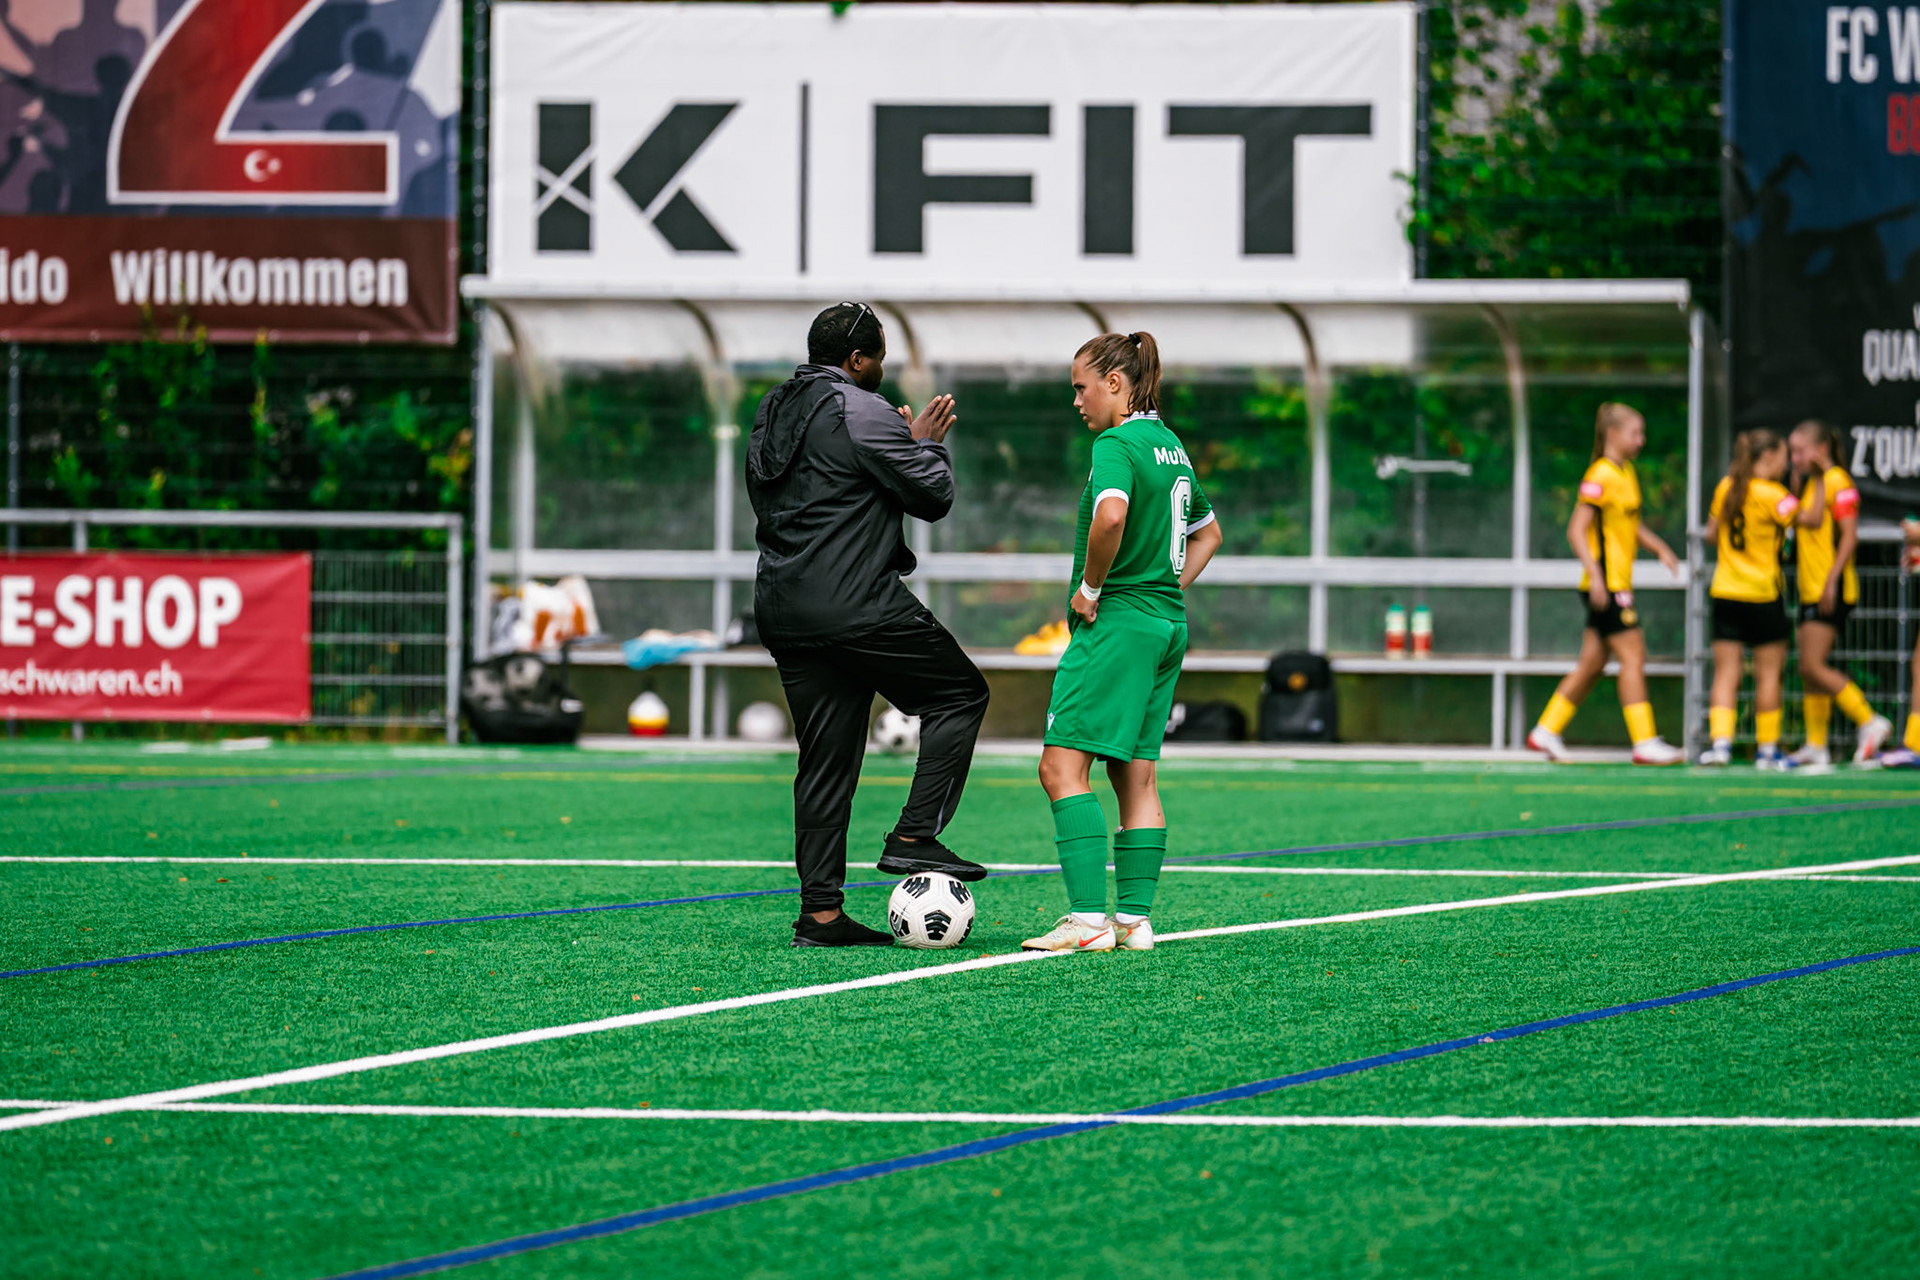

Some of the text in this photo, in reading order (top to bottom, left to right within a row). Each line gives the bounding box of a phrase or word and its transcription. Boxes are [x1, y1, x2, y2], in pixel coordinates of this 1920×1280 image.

[1826, 6, 1879, 83] FC
[872, 102, 1373, 257] FIT
[110, 248, 409, 306] Willkommen
[1170, 476, 1191, 575] 6
[1, 575, 243, 649] E-SHOP
